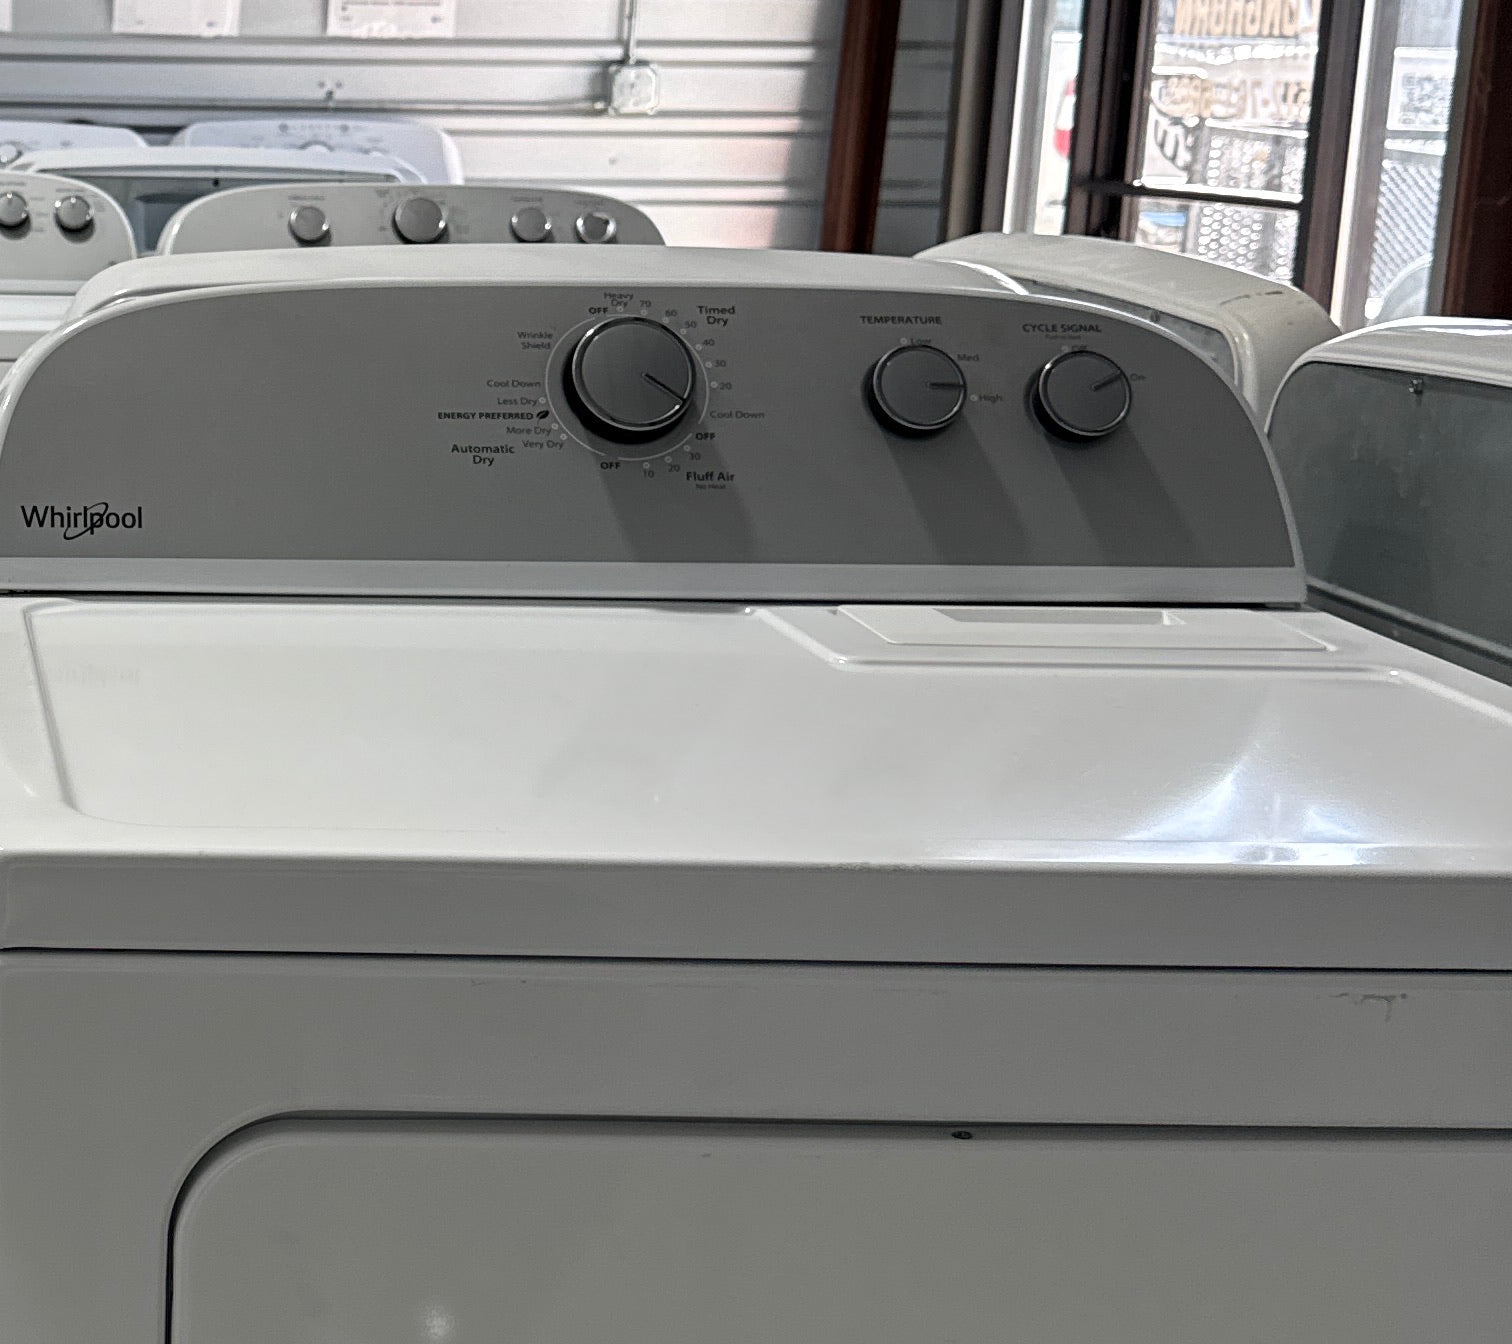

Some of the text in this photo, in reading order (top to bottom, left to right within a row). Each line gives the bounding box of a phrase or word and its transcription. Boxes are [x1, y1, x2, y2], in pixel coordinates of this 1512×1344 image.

[604, 292, 634, 300] Heavy
[588, 307, 608, 315] OFF
[697, 306, 736, 315] Timed
[707, 316, 728, 326] Dry
[860, 316, 943, 325] TEMPERATURE
[1022, 324, 1102, 333] CYCLE SIGNAL
[486, 380, 510, 388] Cool
[497, 398, 538, 407] Less Dry
[437, 412, 534, 420] ENERGY PREFERRED
[709, 411, 734, 420] Cool
[506, 426, 552, 437] More Dry
[695, 432, 716, 441] OFF
[451, 444, 516, 454] Automatic
[522, 439, 565, 450] Very Dry
[473, 455, 495, 467] Dry
[600, 461, 621, 470] OFF
[668, 464, 681, 473] 20
[642, 470, 655, 479] 10
[686, 471, 736, 482] Fluff Air
[20, 504, 143, 537] Whirlpool
